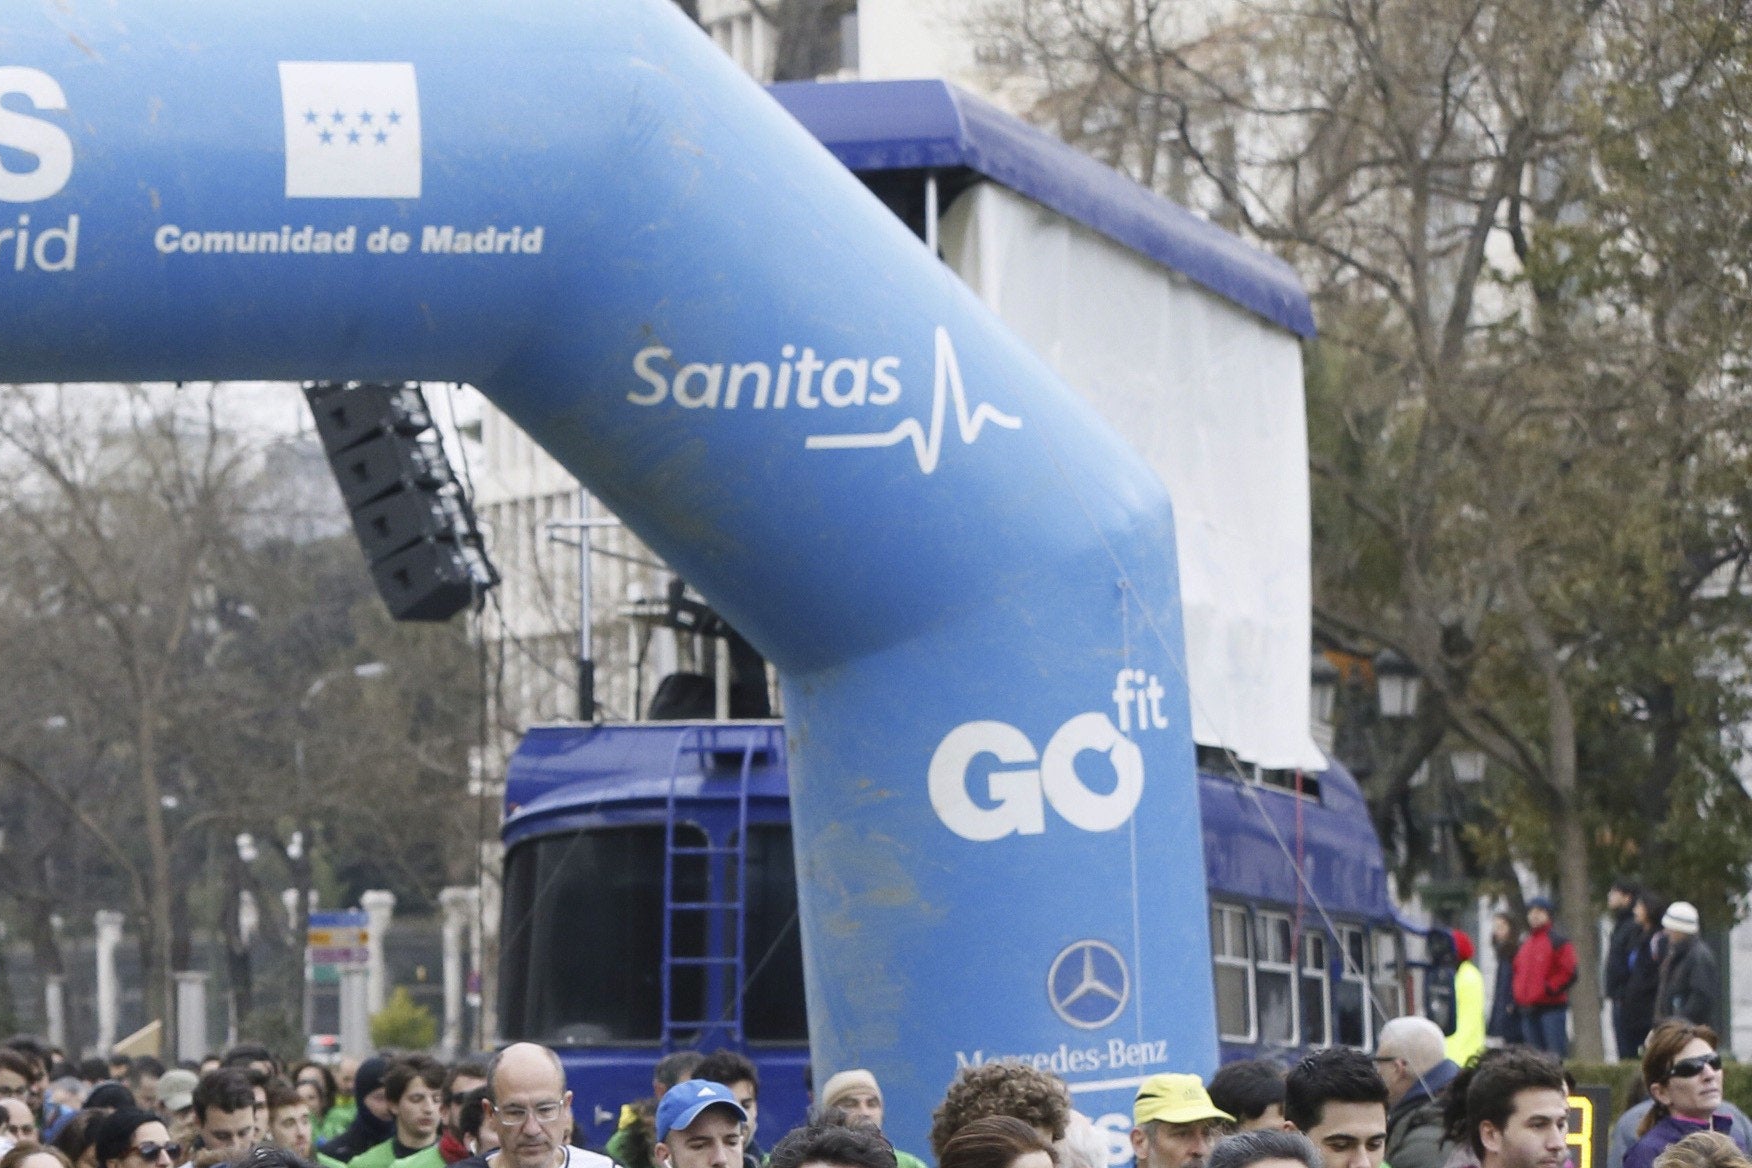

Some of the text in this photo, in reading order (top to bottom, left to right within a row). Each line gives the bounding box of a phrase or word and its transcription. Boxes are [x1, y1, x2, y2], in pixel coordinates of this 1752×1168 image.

[154, 224, 544, 255] Comunidad de Madrid
[627, 343, 902, 410] Sanitas
[1112, 669, 1168, 732] fit
[928, 712, 1145, 843] GO
[955, 1038, 1168, 1080] Medes-Benz
